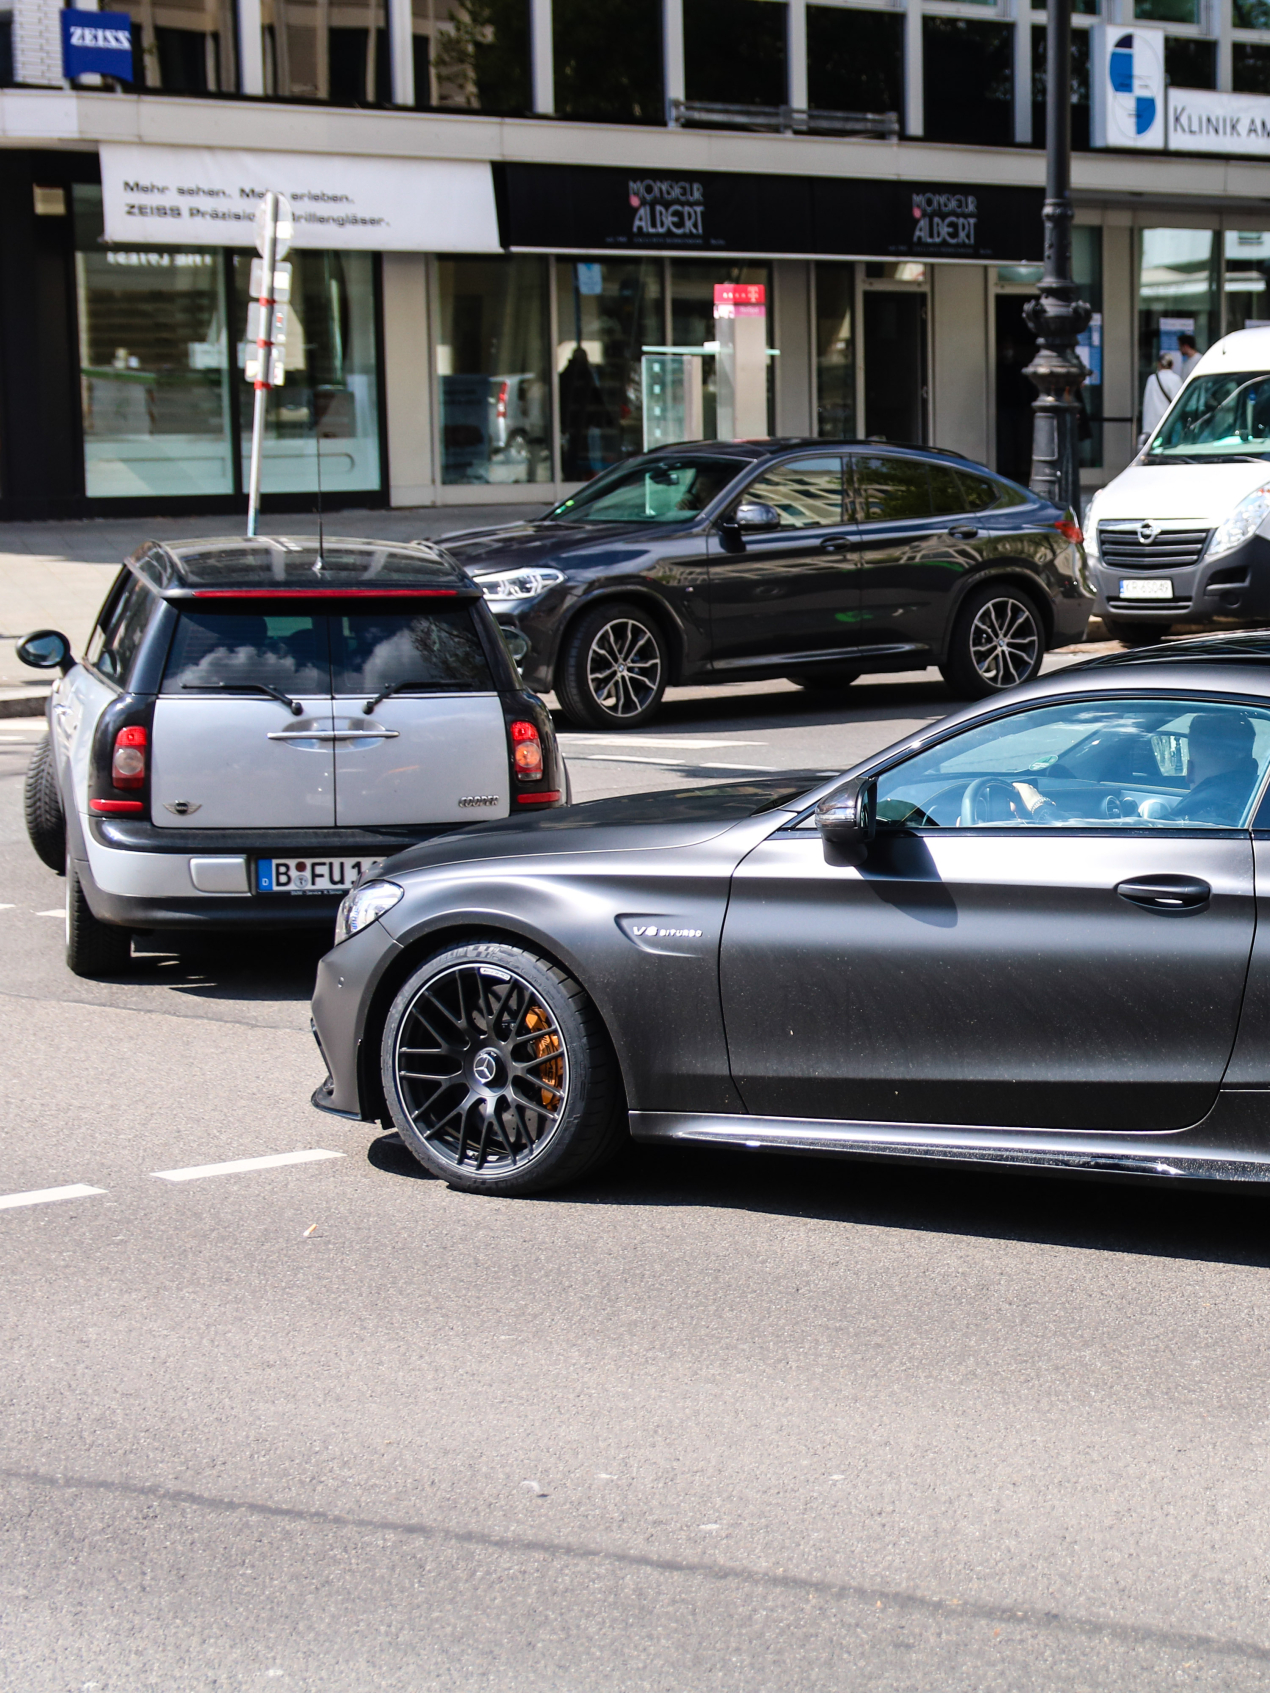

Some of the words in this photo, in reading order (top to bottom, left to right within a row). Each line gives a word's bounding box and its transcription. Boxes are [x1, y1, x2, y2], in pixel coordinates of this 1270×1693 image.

[69, 26, 132, 51] ZEISS
[1173, 104, 1242, 136] KLINIK
[123, 181, 170, 194] Mehr
[628, 179, 704, 202] MONSIEUR
[125, 203, 182, 218] ZEISS
[911, 192, 978, 214] MONSIEUR
[632, 204, 705, 235] ALBERT
[913, 216, 978, 245] ALBERT
[458, 795, 500, 808] COOPER
[275, 862, 292, 887] B
[659, 928, 703, 938] BITURBO
